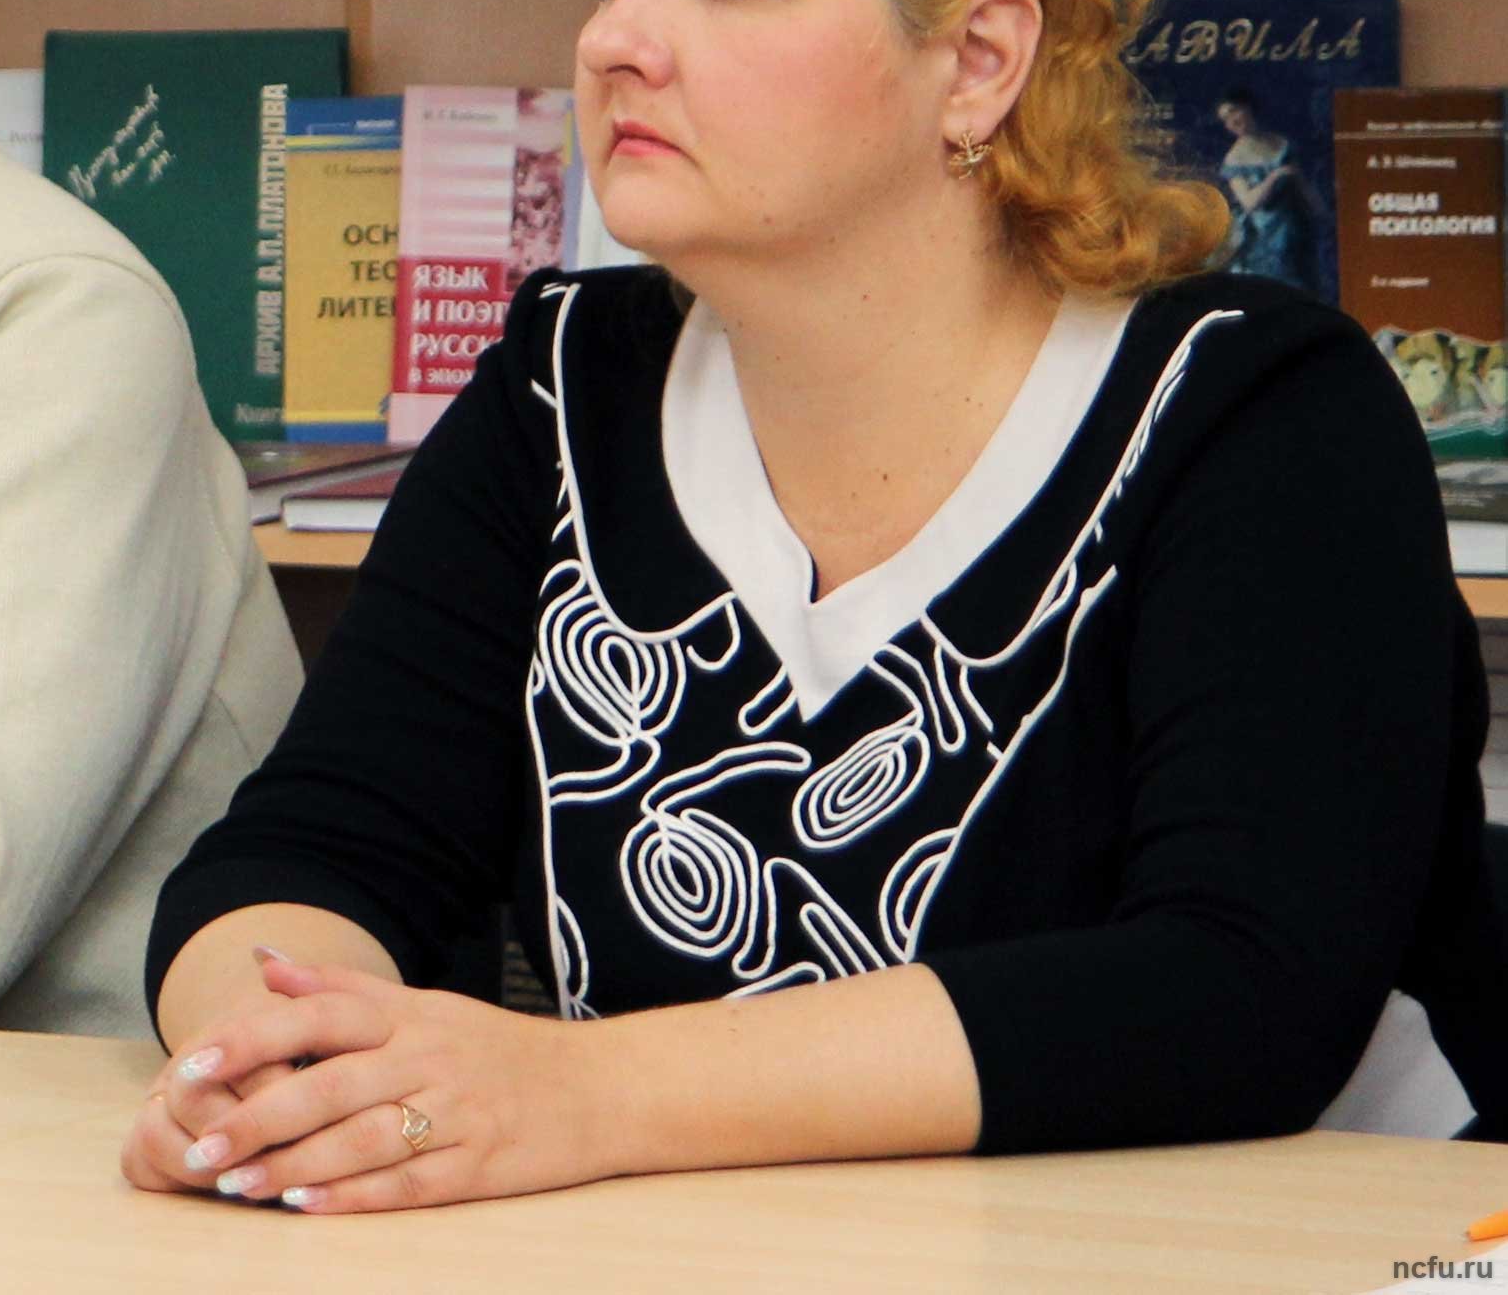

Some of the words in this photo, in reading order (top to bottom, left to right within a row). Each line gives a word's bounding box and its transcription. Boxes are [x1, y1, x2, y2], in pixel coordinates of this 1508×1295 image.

[1368, 192, 1440, 214] ОБЩАЯ
[1369, 215, 1498, 237] ПСИХОЛОГИЯ
[411, 264, 489, 291] ЯЗЫК
[411, 298, 430, 324] И
